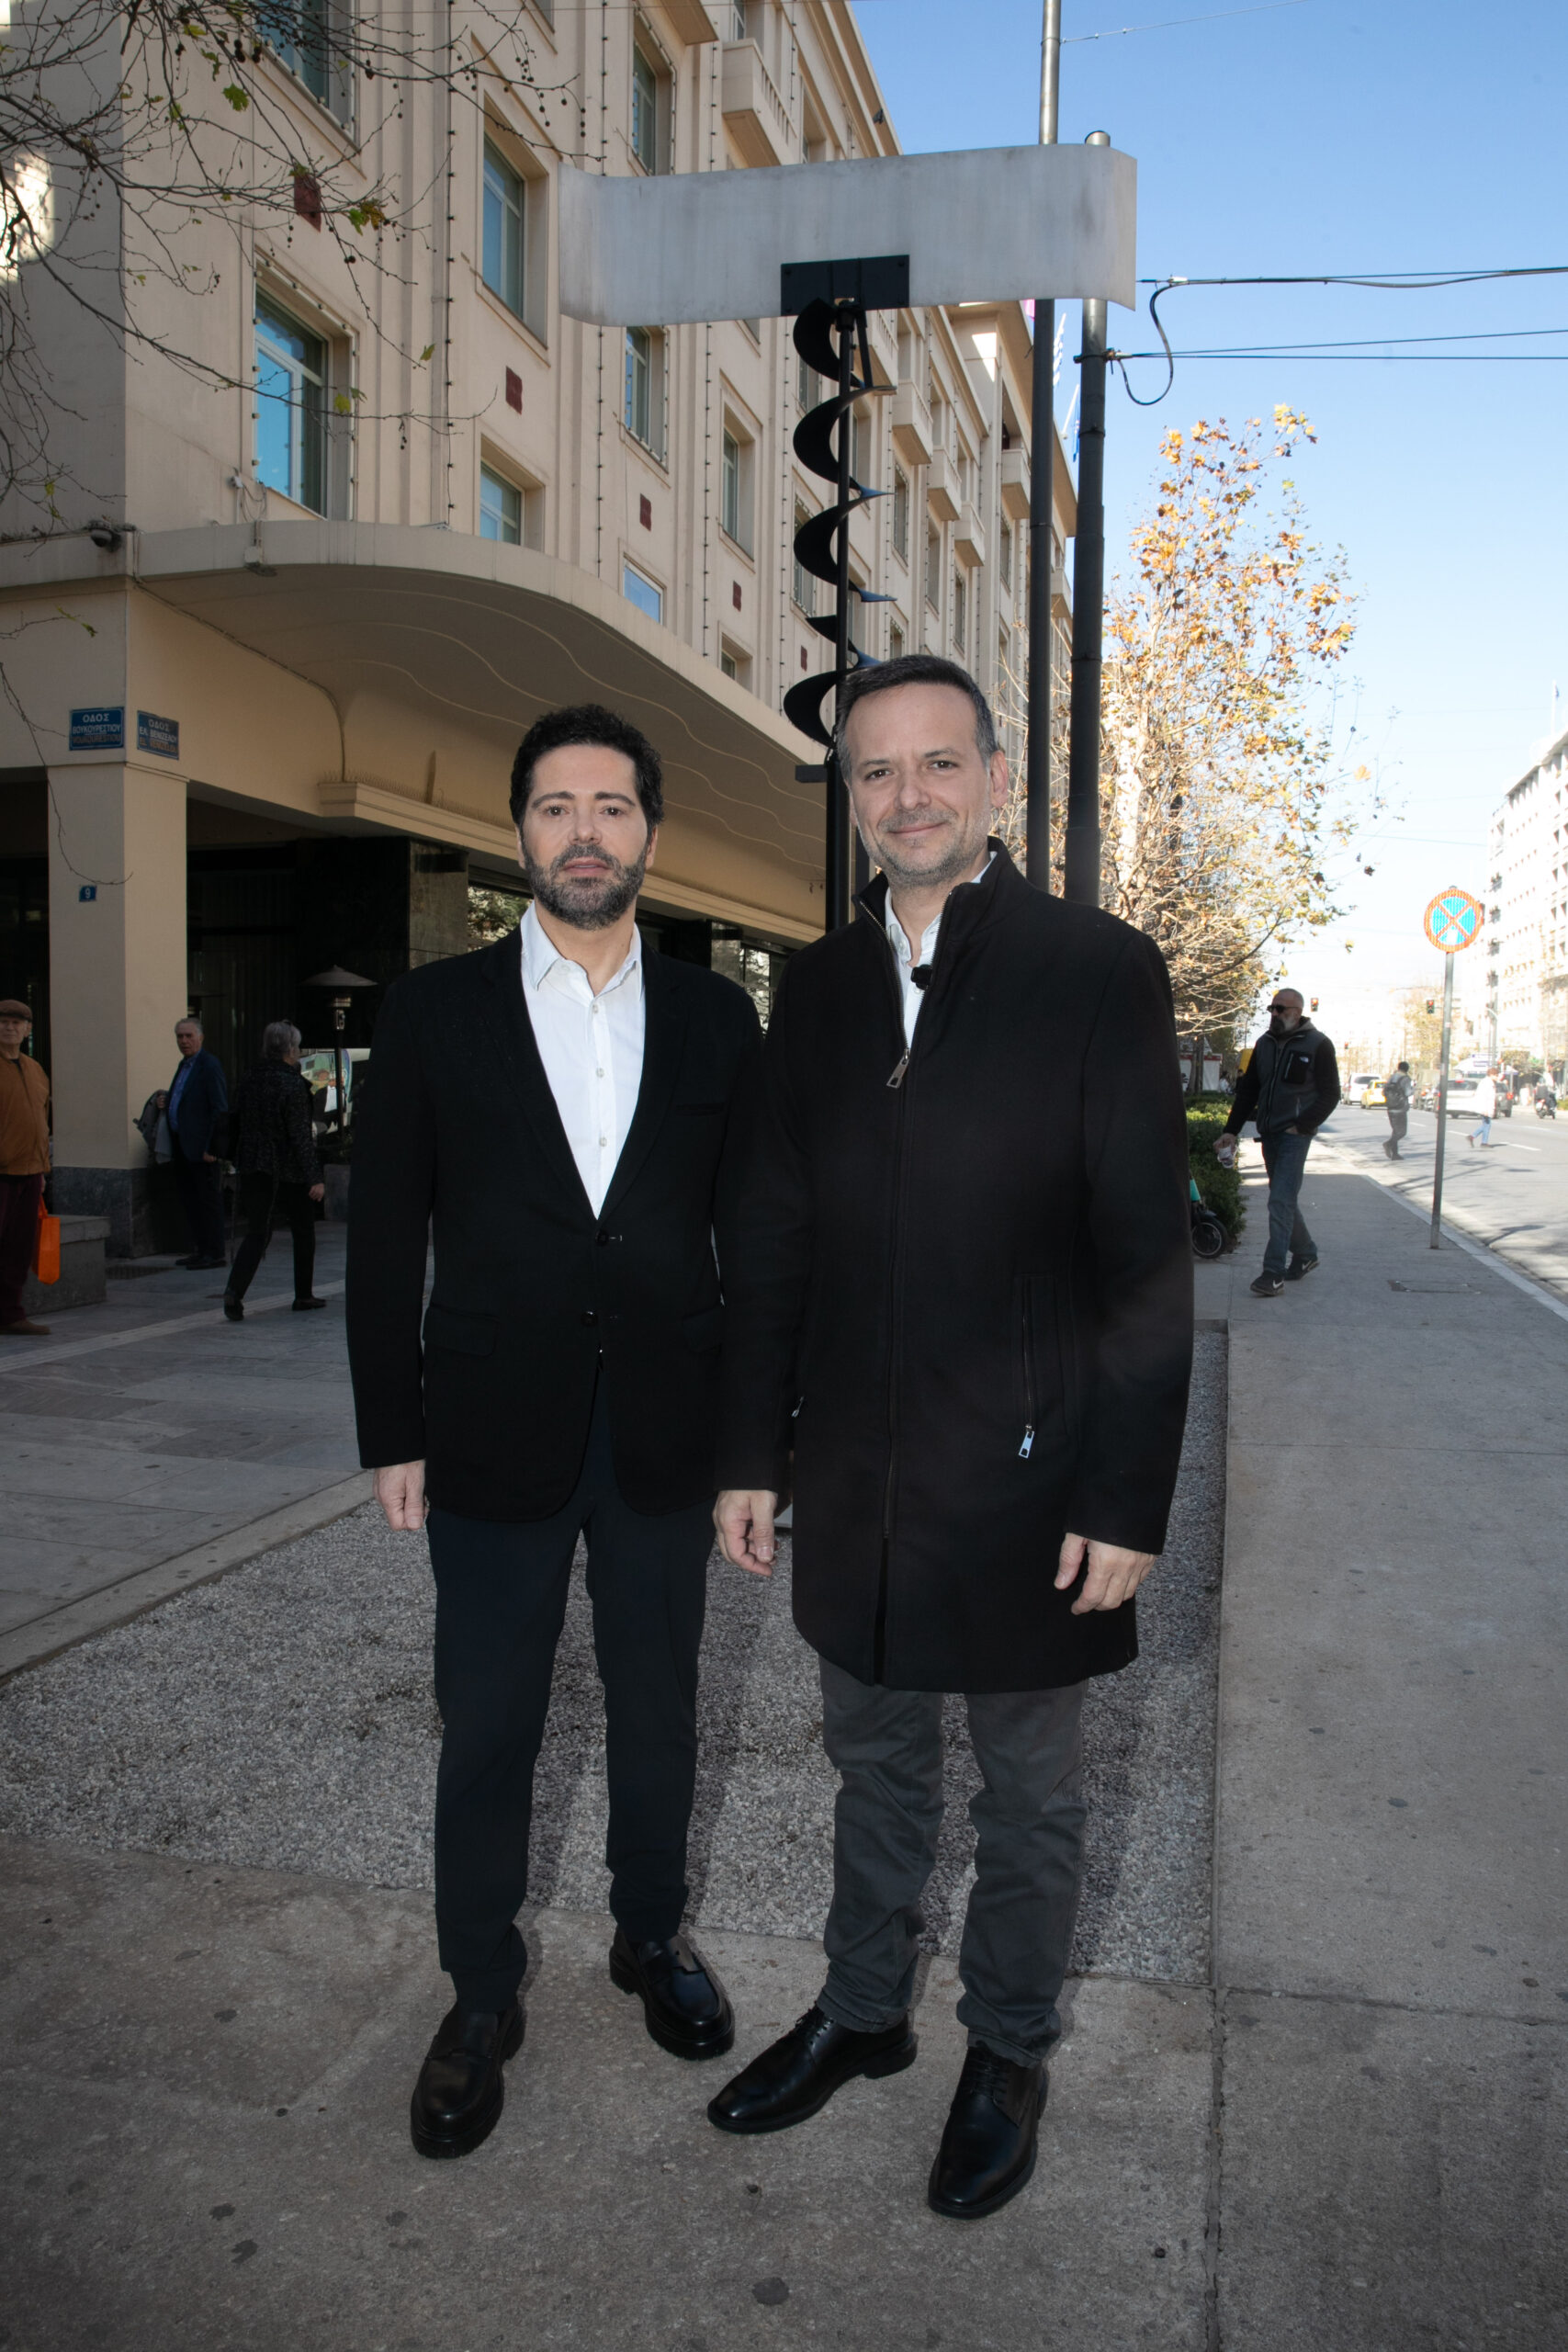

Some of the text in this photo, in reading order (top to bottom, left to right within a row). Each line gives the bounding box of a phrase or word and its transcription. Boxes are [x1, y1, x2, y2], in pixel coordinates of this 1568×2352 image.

[83, 713, 109, 722] ΟΔΟΣ
[148, 719, 170, 731] ΟΔΟΣ
[85, 888, 91, 899] 9
